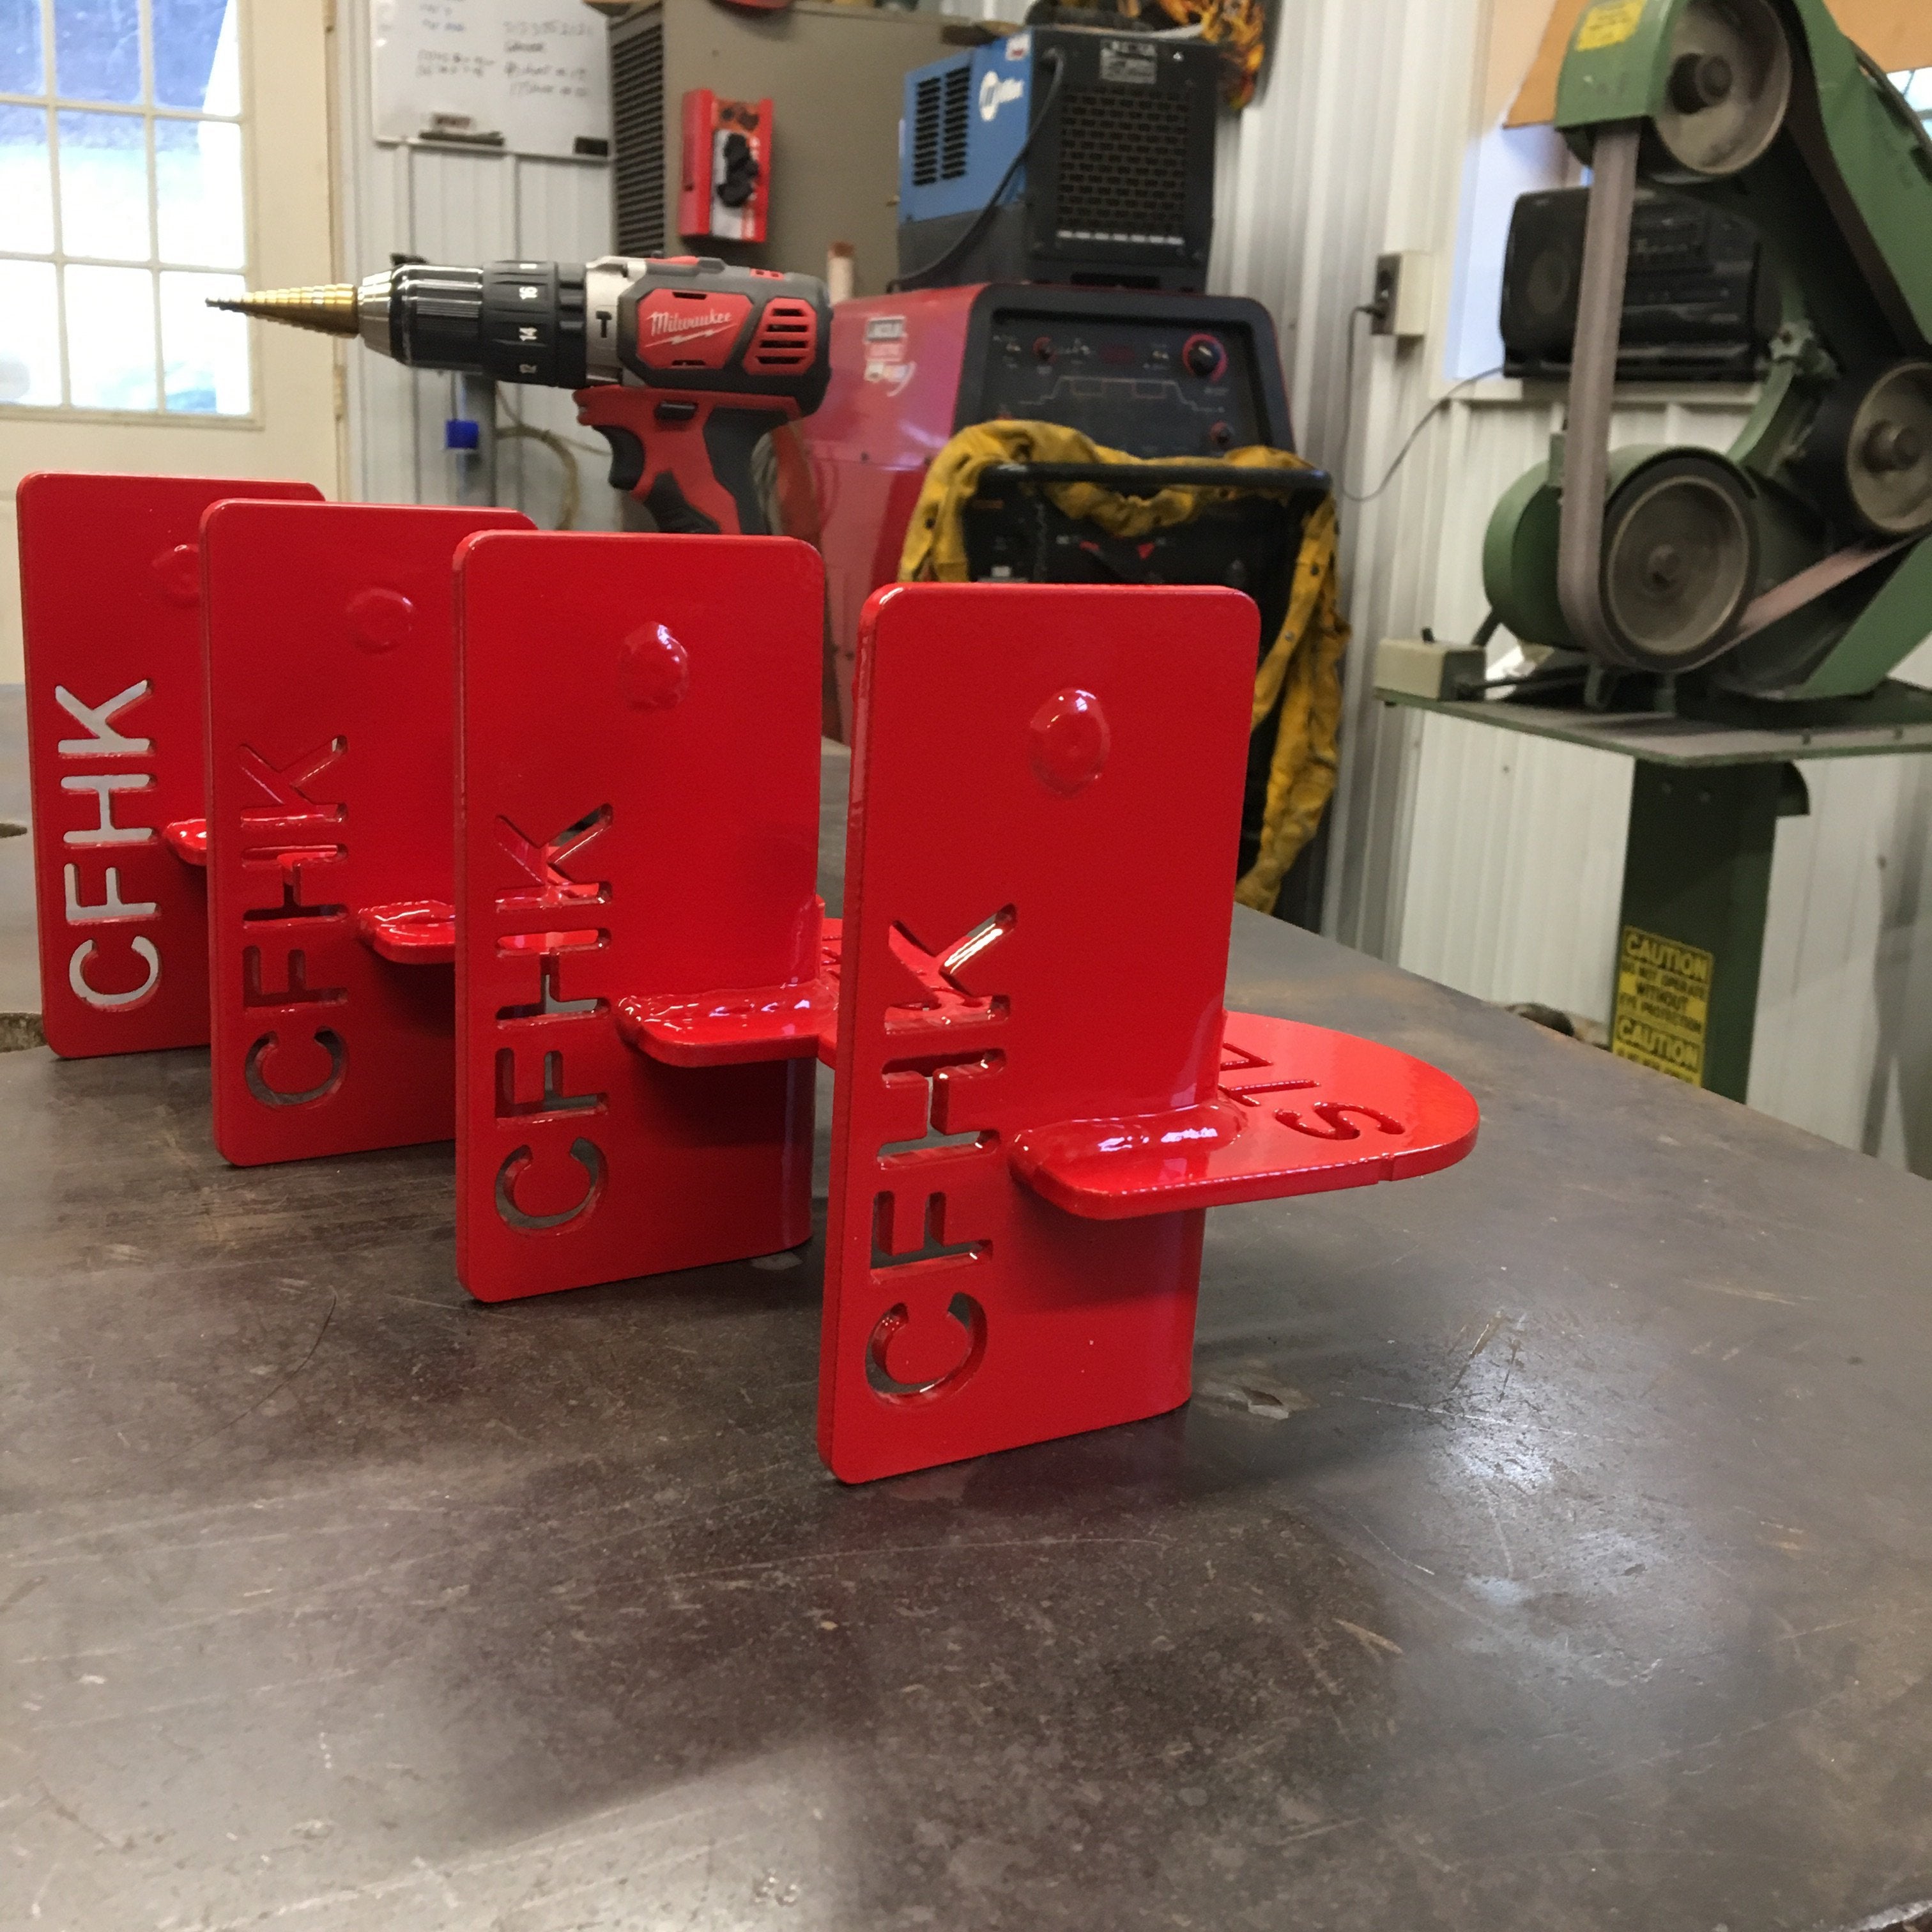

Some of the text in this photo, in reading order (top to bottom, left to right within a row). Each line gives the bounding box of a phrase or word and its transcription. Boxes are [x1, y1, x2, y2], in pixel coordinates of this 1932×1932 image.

[519, 327, 537, 342] 14
[646, 308, 732, 337] Milwaukee
[55, 679, 162, 1011] CFHK
[238, 734, 349, 1110] CFHK
[495, 803, 613, 1238] CFHK
[1620, 1018, 1699, 1071] CAUTION
[1625, 933, 1708, 982] CAUTION
[864, 903, 1018, 1407] CFHK
